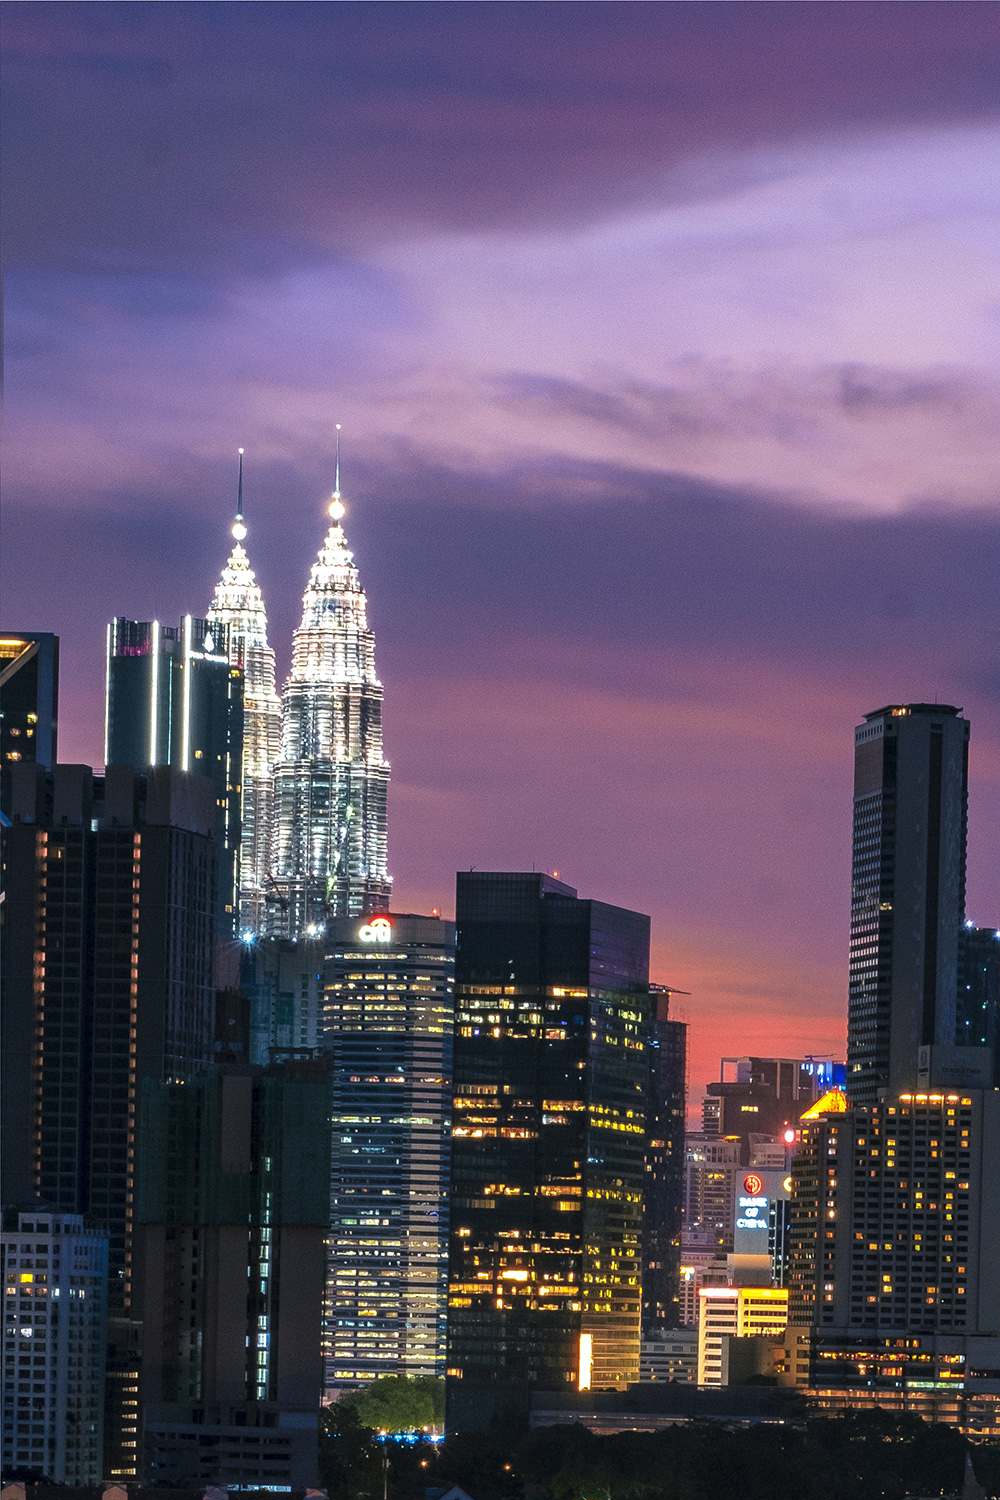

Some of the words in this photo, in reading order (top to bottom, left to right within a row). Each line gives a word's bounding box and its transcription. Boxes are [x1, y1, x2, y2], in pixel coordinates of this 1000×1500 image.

[739, 1197, 768, 1207] BANK
[745, 1207, 759, 1218] OF
[736, 1218, 768, 1229] CHINA
